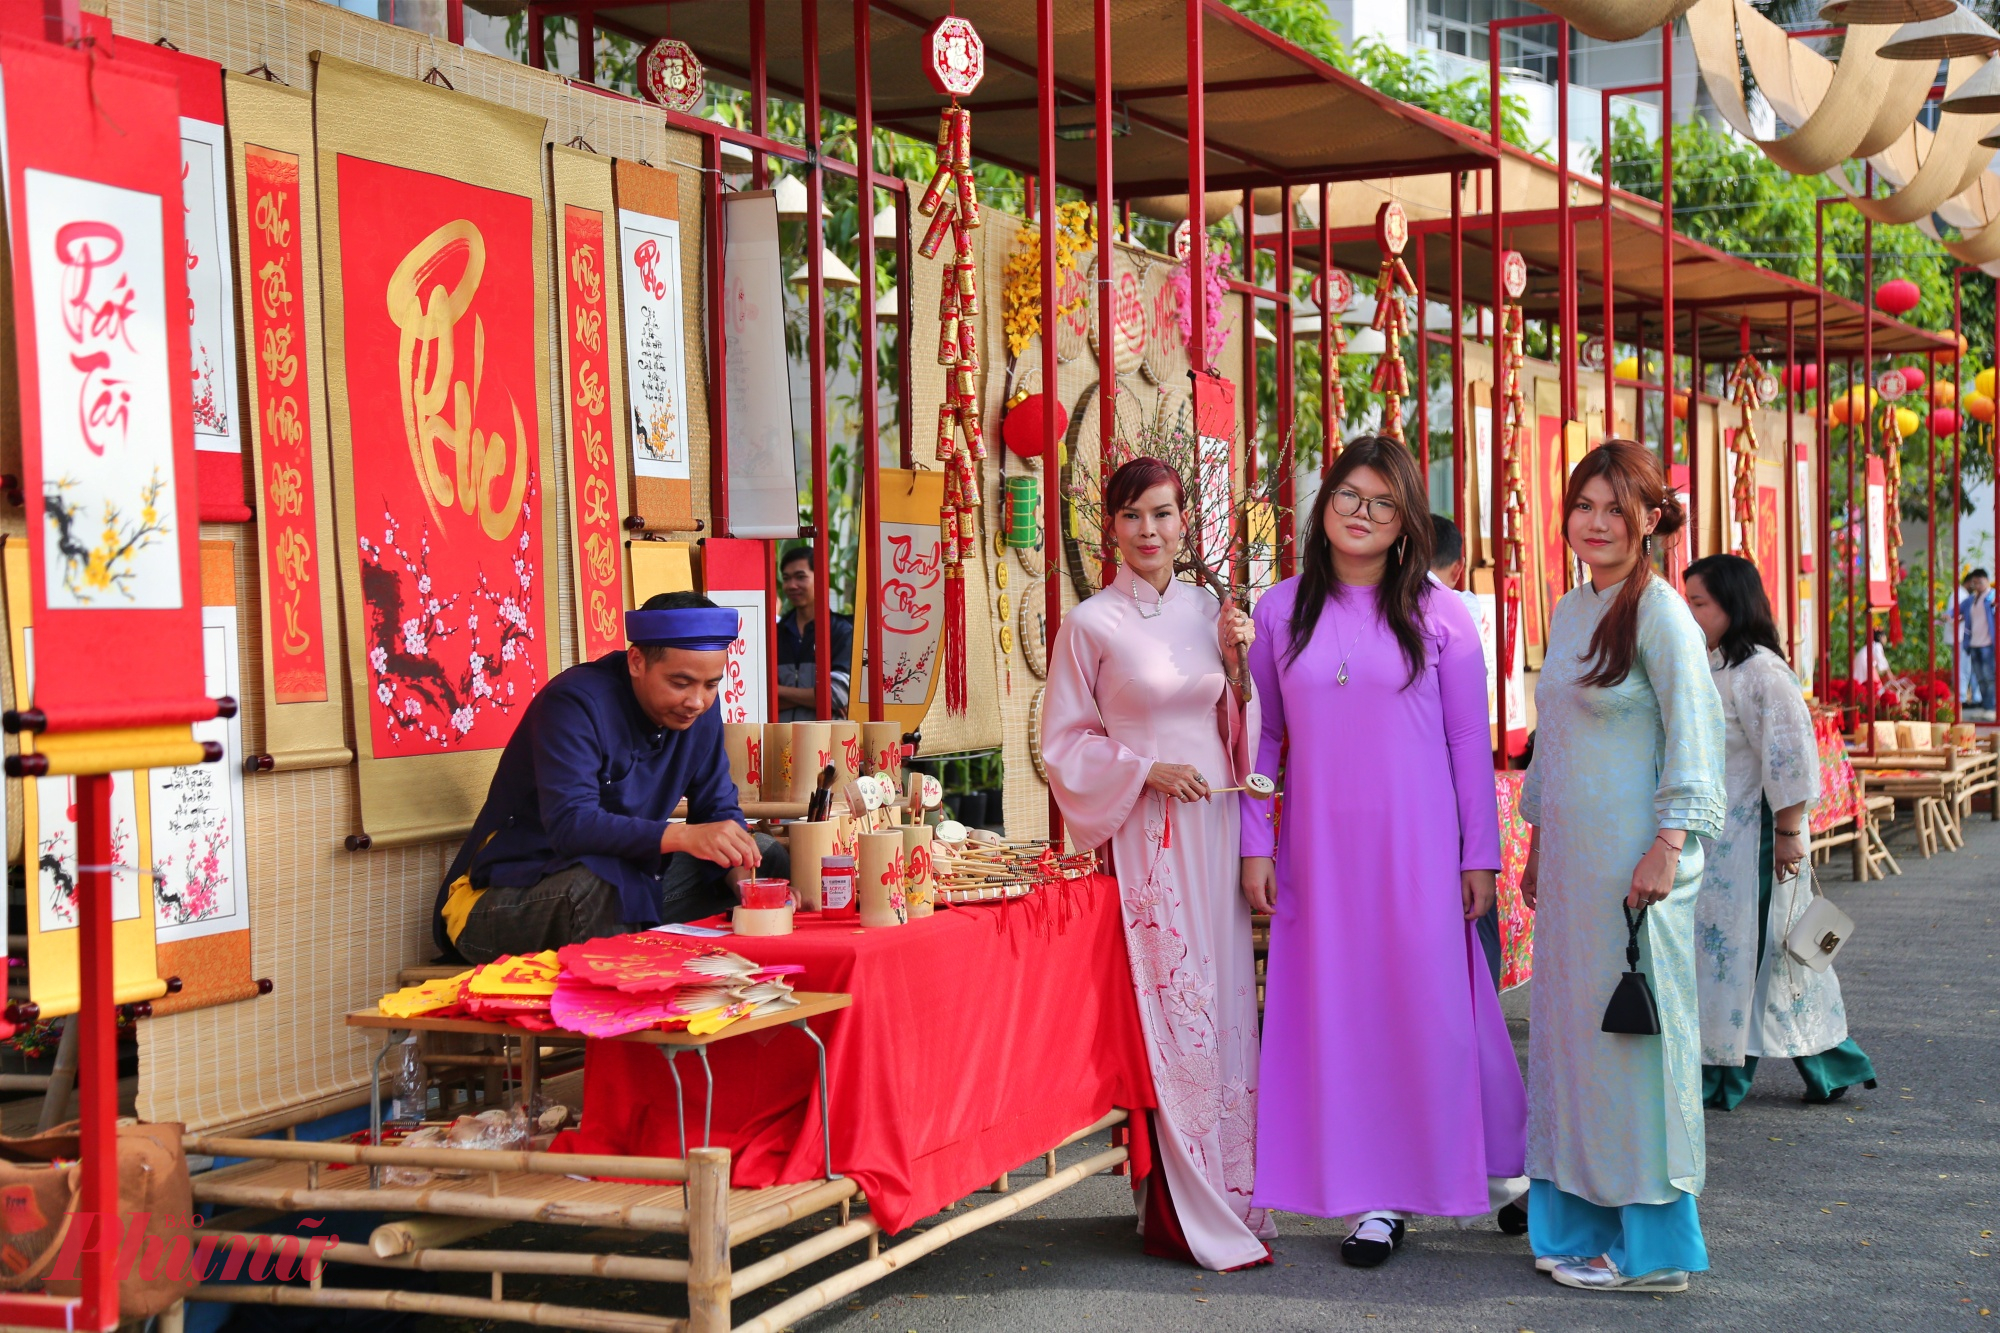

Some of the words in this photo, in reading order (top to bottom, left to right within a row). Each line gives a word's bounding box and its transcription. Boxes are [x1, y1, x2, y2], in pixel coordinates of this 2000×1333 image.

[661, 58, 687, 91] 福
[946, 37, 969, 72] 福
[55, 220, 137, 353] Phát
[634, 239, 667, 301] Phúc
[69, 352, 132, 457] Tài
[386, 218, 528, 543] Phúc
[881, 578, 932, 635] Công
